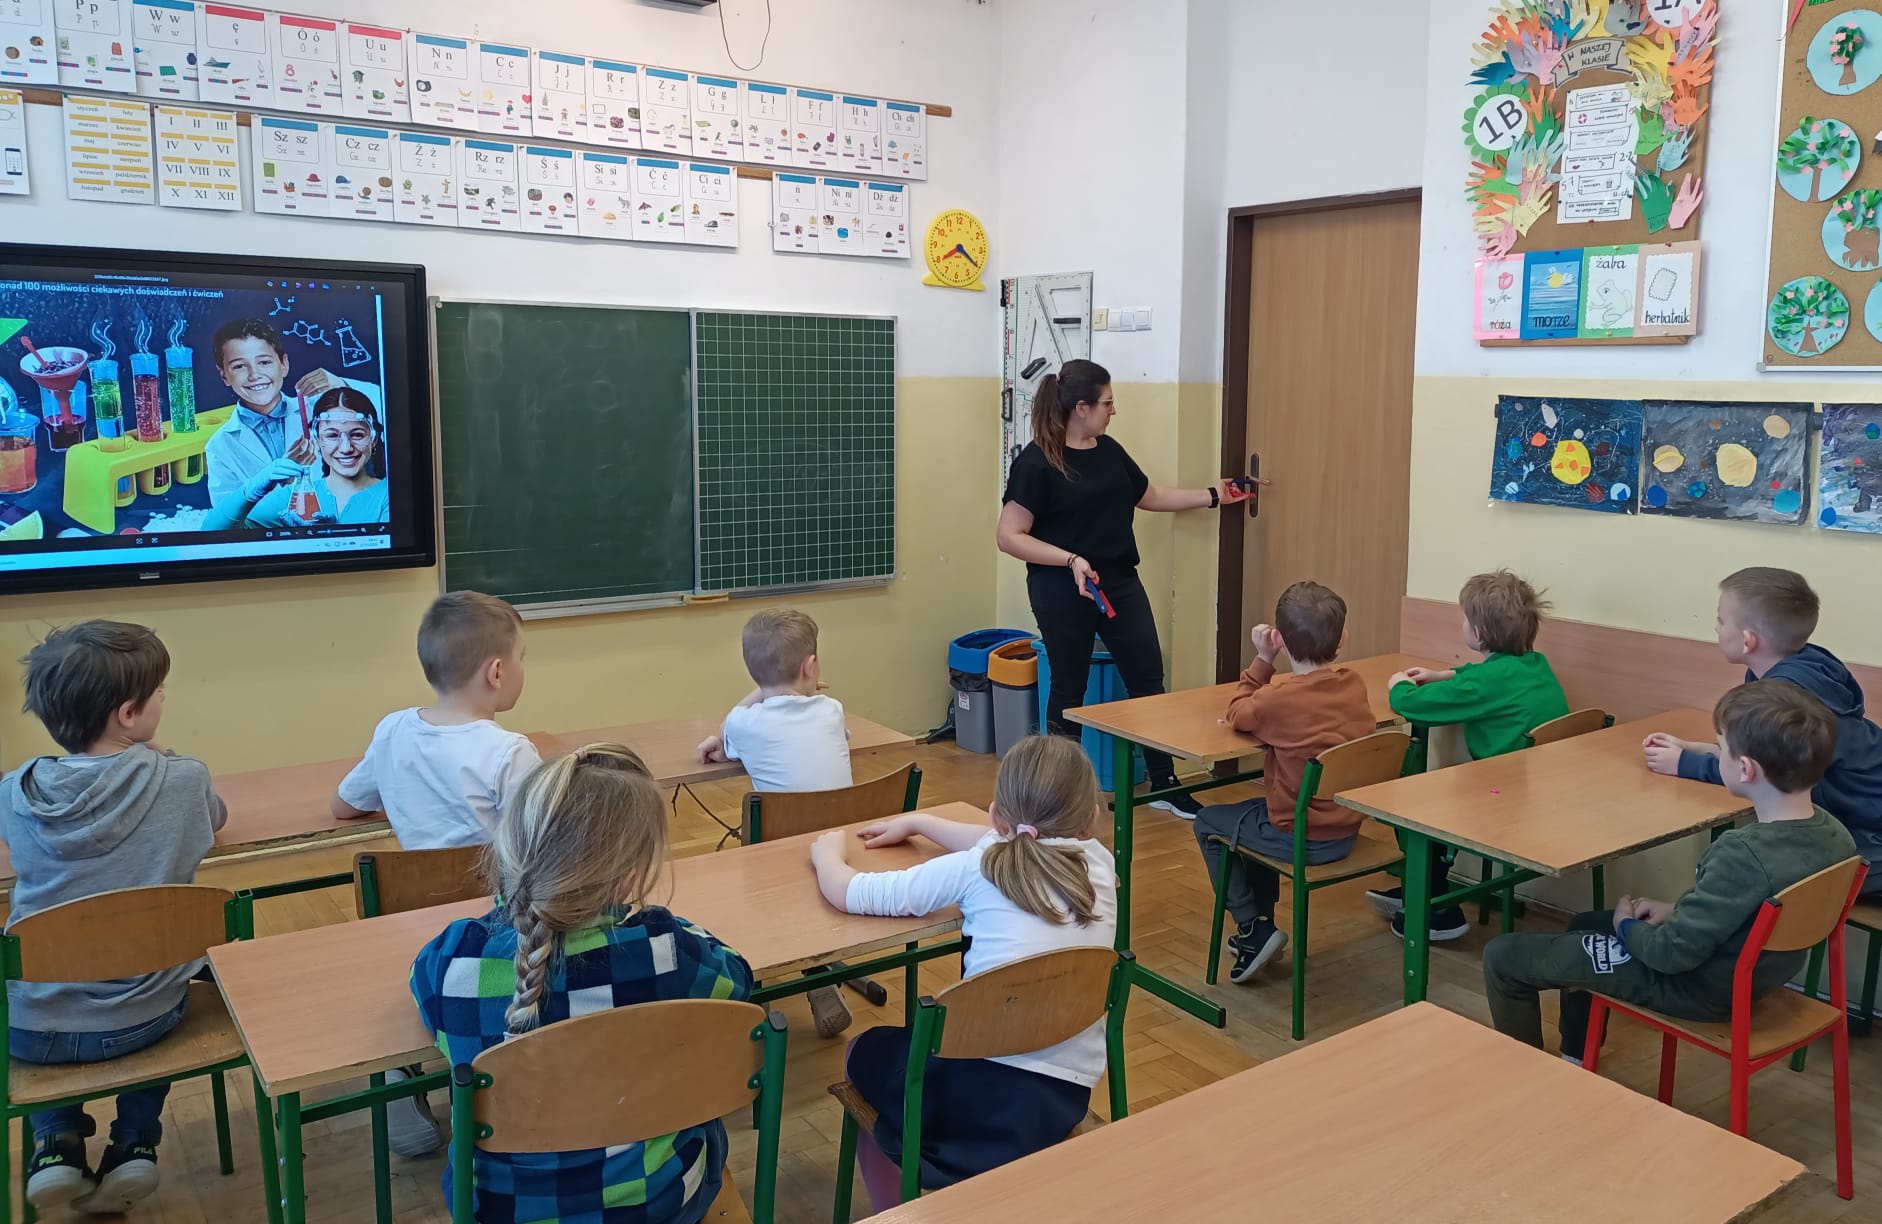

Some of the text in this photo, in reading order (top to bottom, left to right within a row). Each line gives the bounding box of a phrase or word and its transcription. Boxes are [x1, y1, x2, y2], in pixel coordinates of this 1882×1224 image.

[90, 3, 98, 14] p
[149, 9, 180, 23] W w
[298, 28, 320, 42] Ó ó
[366, 39, 374, 50] U
[432, 48, 452, 60] N n
[1568, 42, 1611, 61] W NASZEJ
[496, 56, 514, 68] C c
[1582, 53, 1611, 66] KLASIE
[285, 64, 295, 76] 8
[555, 64, 569, 78] J j
[607, 72, 614, 82] R
[658, 80, 666, 90] Z
[708, 87, 727, 100] G g
[760, 94, 775, 104] L l
[808, 100, 823, 111] F f
[852, 107, 868, 117] H h
[892, 112, 915, 123] Ch ch
[170, 116, 173, 125] I
[193, 119, 200, 128] II
[1479, 100, 1522, 144] 1B
[216, 122, 227, 131] III
[274, 130, 308, 144] Sz sz
[167, 140, 179, 150] IV
[194, 142, 202, 151] V
[217, 145, 229, 154] VI
[346, 138, 380, 151] Cz cz
[416, 144, 437, 157] Ż ż
[475, 152, 488, 162] Rz
[166, 164, 182, 174] VII
[541, 157, 559, 170] Ś ś
[190, 166, 209, 176] VIII
[219, 168, 231, 178] IX
[594, 164, 617, 175] Si si
[649, 168, 667, 180] Ć ć
[699, 175, 721, 185] Ci ci
[172, 188, 180, 197] X
[195, 190, 207, 199] XI
[218, 192, 234, 200] XII
[832, 188, 852, 198] Ni ni
[873, 192, 898, 202] Dż dż
[969, 220, 972, 229] 1
[938, 228, 945, 236] 10
[1596, 256, 1627, 269] żaba
[25, 282, 40, 290] 100
[42, 284, 89, 292] możliwości
[91, 285, 134, 296] ciekawych
[136, 287, 187, 296] doświadczeń
[193, 289, 224, 298] ćwiczeń
[1645, 306, 1690, 324] herbatnik
[1490, 318, 1511, 330] róża
[1534, 315, 1570, 328] morze
[1595, 940, 1608, 970] WORLD
[39, 1155, 63, 1166] FILA
